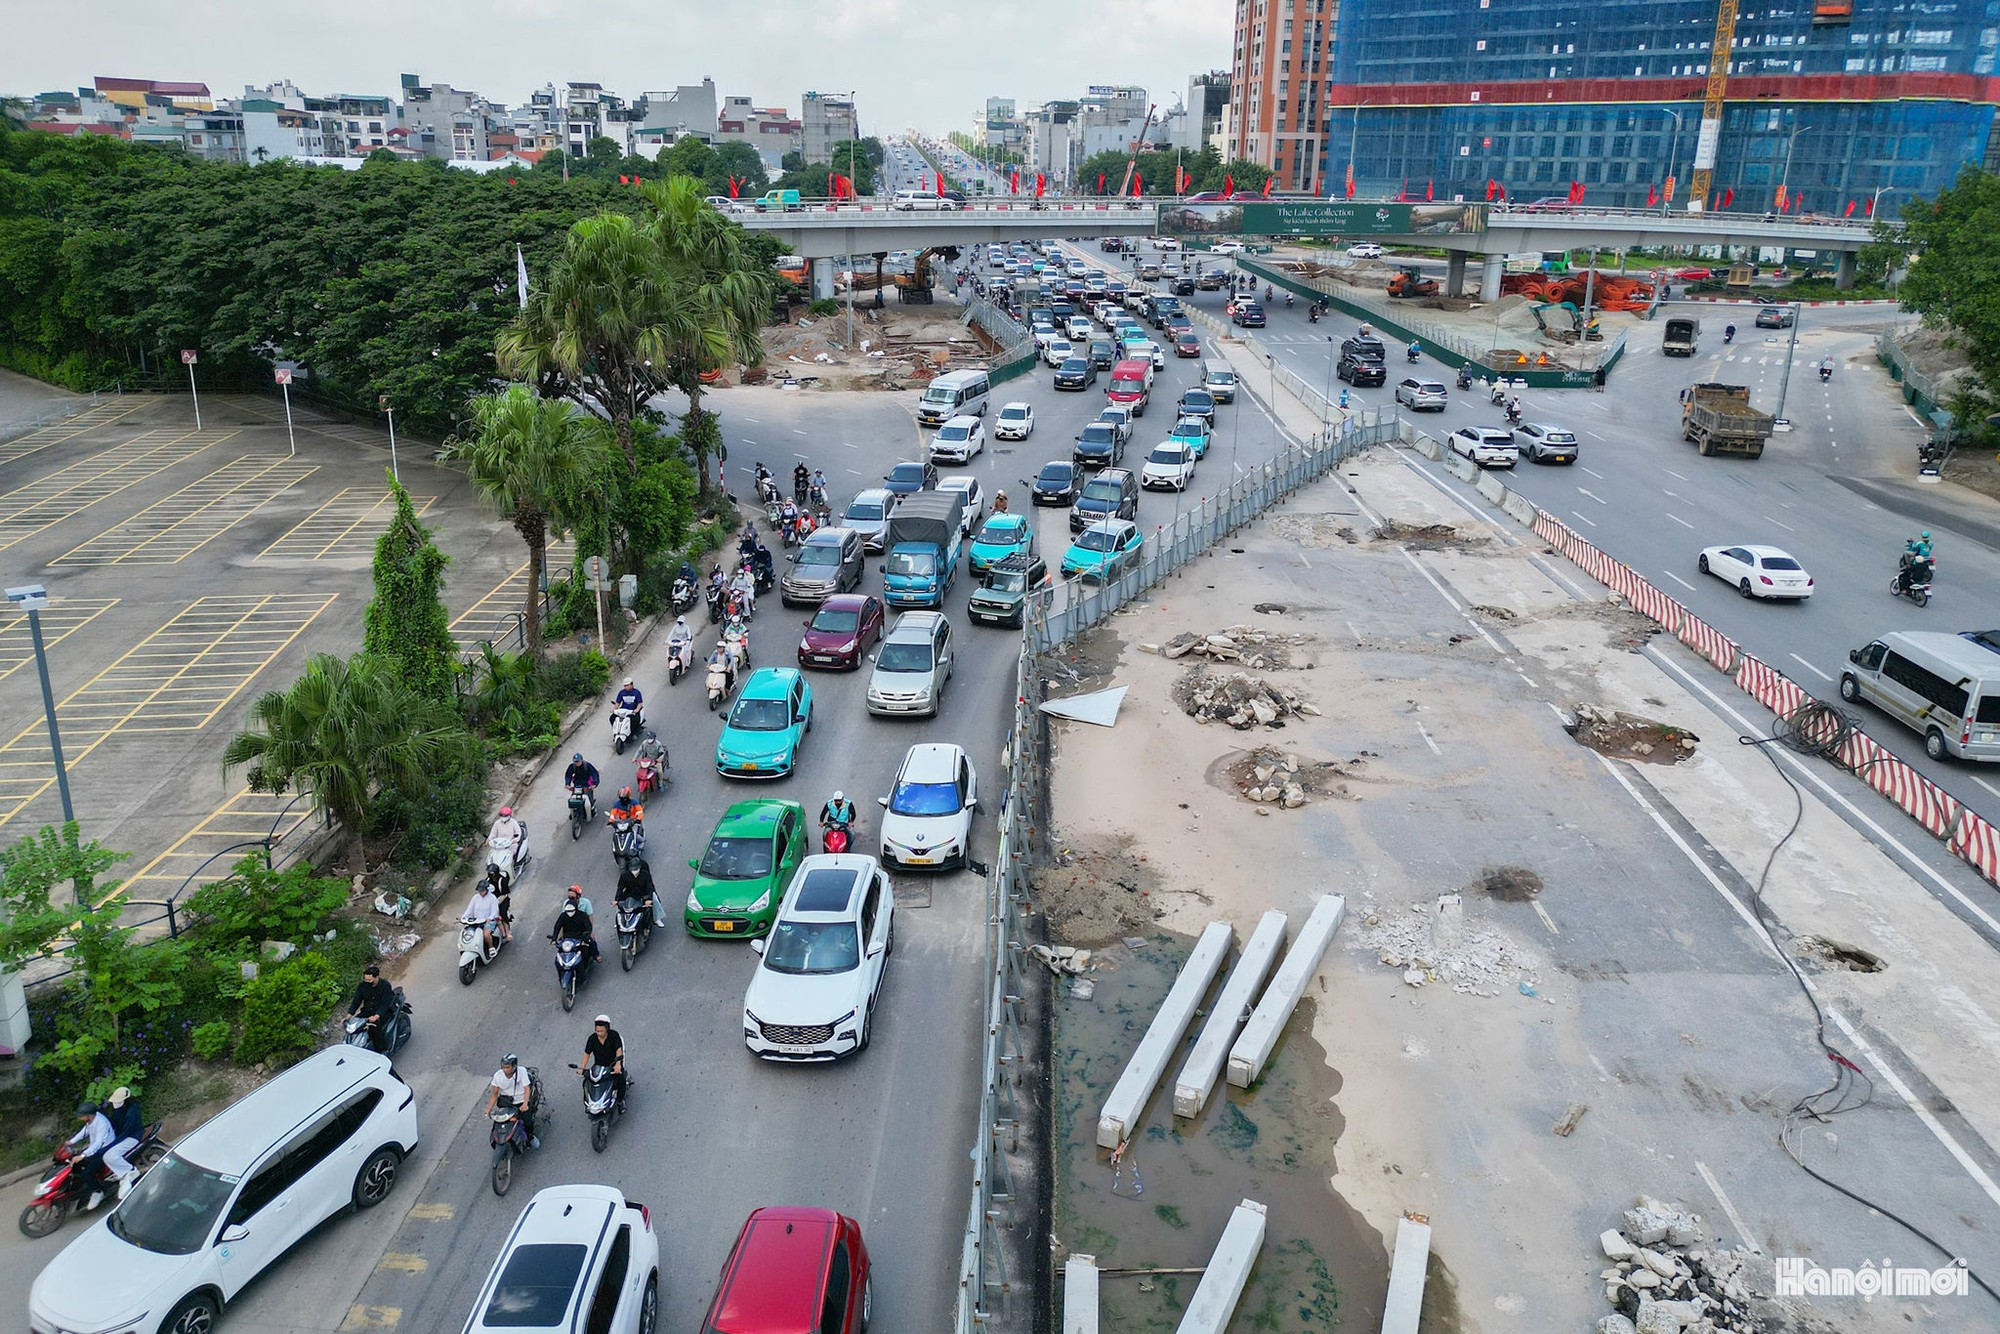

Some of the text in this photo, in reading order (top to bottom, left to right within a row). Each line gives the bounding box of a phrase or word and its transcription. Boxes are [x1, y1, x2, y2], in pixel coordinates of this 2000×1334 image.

[1277, 207, 1354, 217] The Lake Collection
